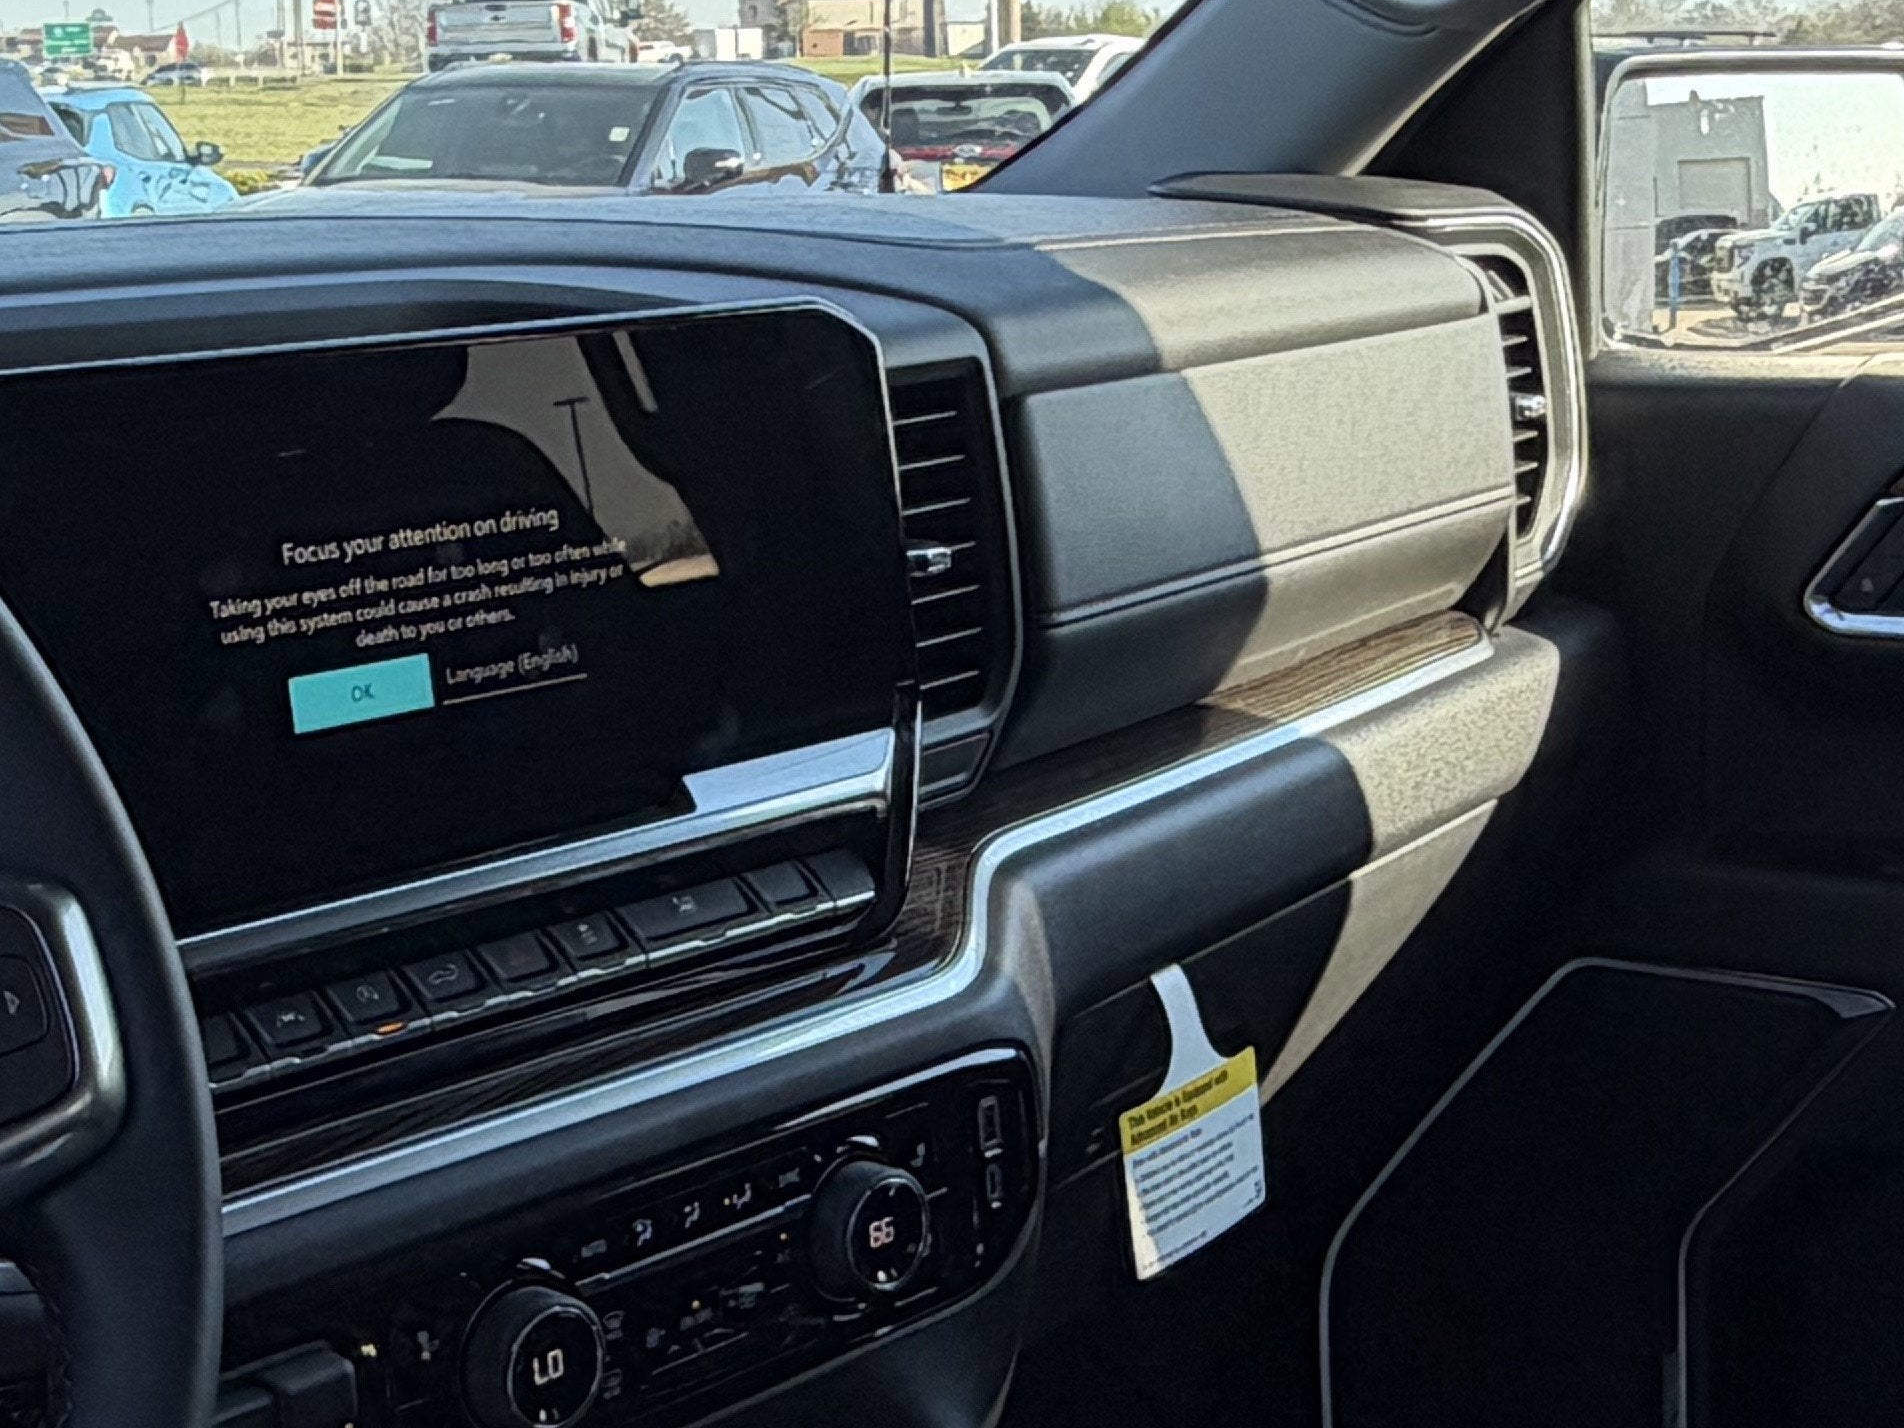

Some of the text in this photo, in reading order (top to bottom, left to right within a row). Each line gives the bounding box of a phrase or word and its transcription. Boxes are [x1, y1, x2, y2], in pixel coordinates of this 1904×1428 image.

[282, 507, 560, 565] Focus your attention on driving
[209, 598, 262, 619] Taking
[264, 592, 298, 615] your
[302, 587, 337, 608] eyes
[339, 576, 361, 598] off
[364, 575, 389, 594] the
[392, 567, 425, 590] road
[427, 565, 447, 583] for
[450, 564, 475, 581] too
[477, 558, 509, 578] long
[511, 556, 526, 571] or
[528, 552, 552, 568] too
[554, 543, 591, 563] often
[220, 563, 624, 646] using this system could cause a crash resulting in injury or
[355, 625, 400, 648] death
[400, 624, 417, 640] to
[418, 621, 446, 642] you
[446, 616, 464, 632] or
[446, 642, 579, 685] Language (English)
[350, 682, 376, 703] OK
[532, 1348, 565, 1386] LO
